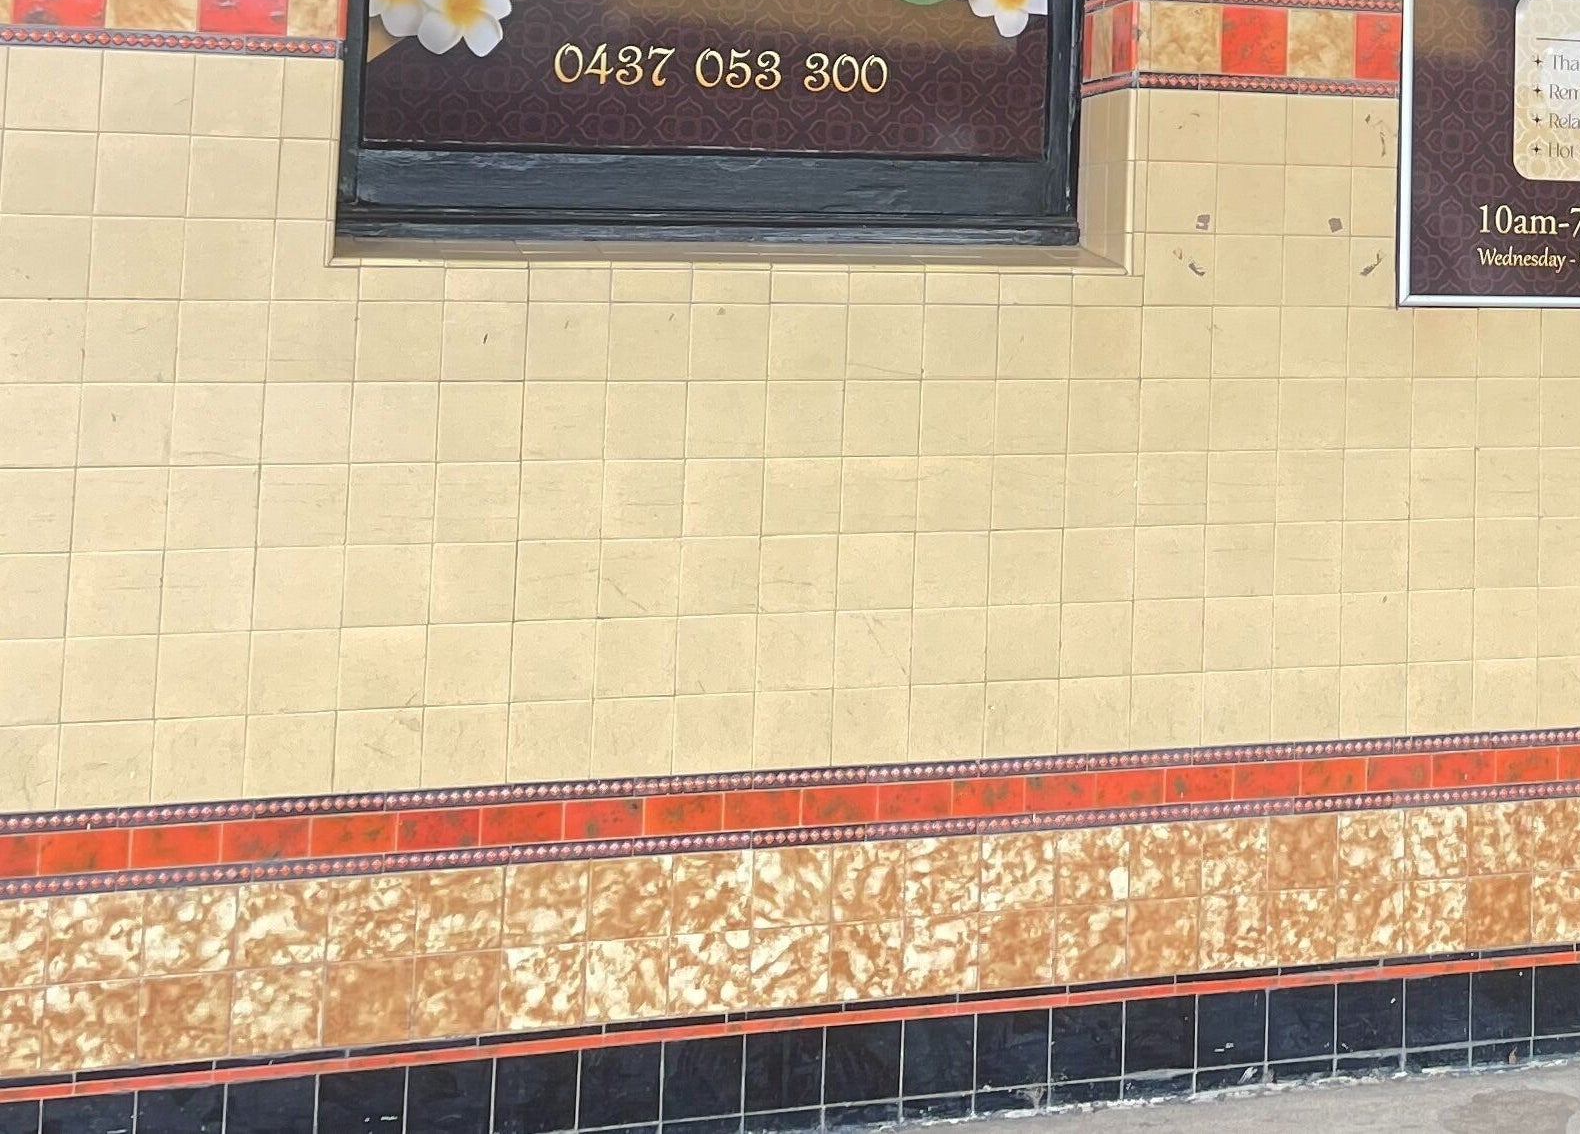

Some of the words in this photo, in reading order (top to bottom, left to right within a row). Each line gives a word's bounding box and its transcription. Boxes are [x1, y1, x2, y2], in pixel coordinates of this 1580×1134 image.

[553, 42, 676, 87] 0437
[695, 47, 782, 91] 053
[803, 52, 889, 93] 300
[1548, 141, 1576, 159] Hot
[1477, 246, 1567, 270] Wednesday
